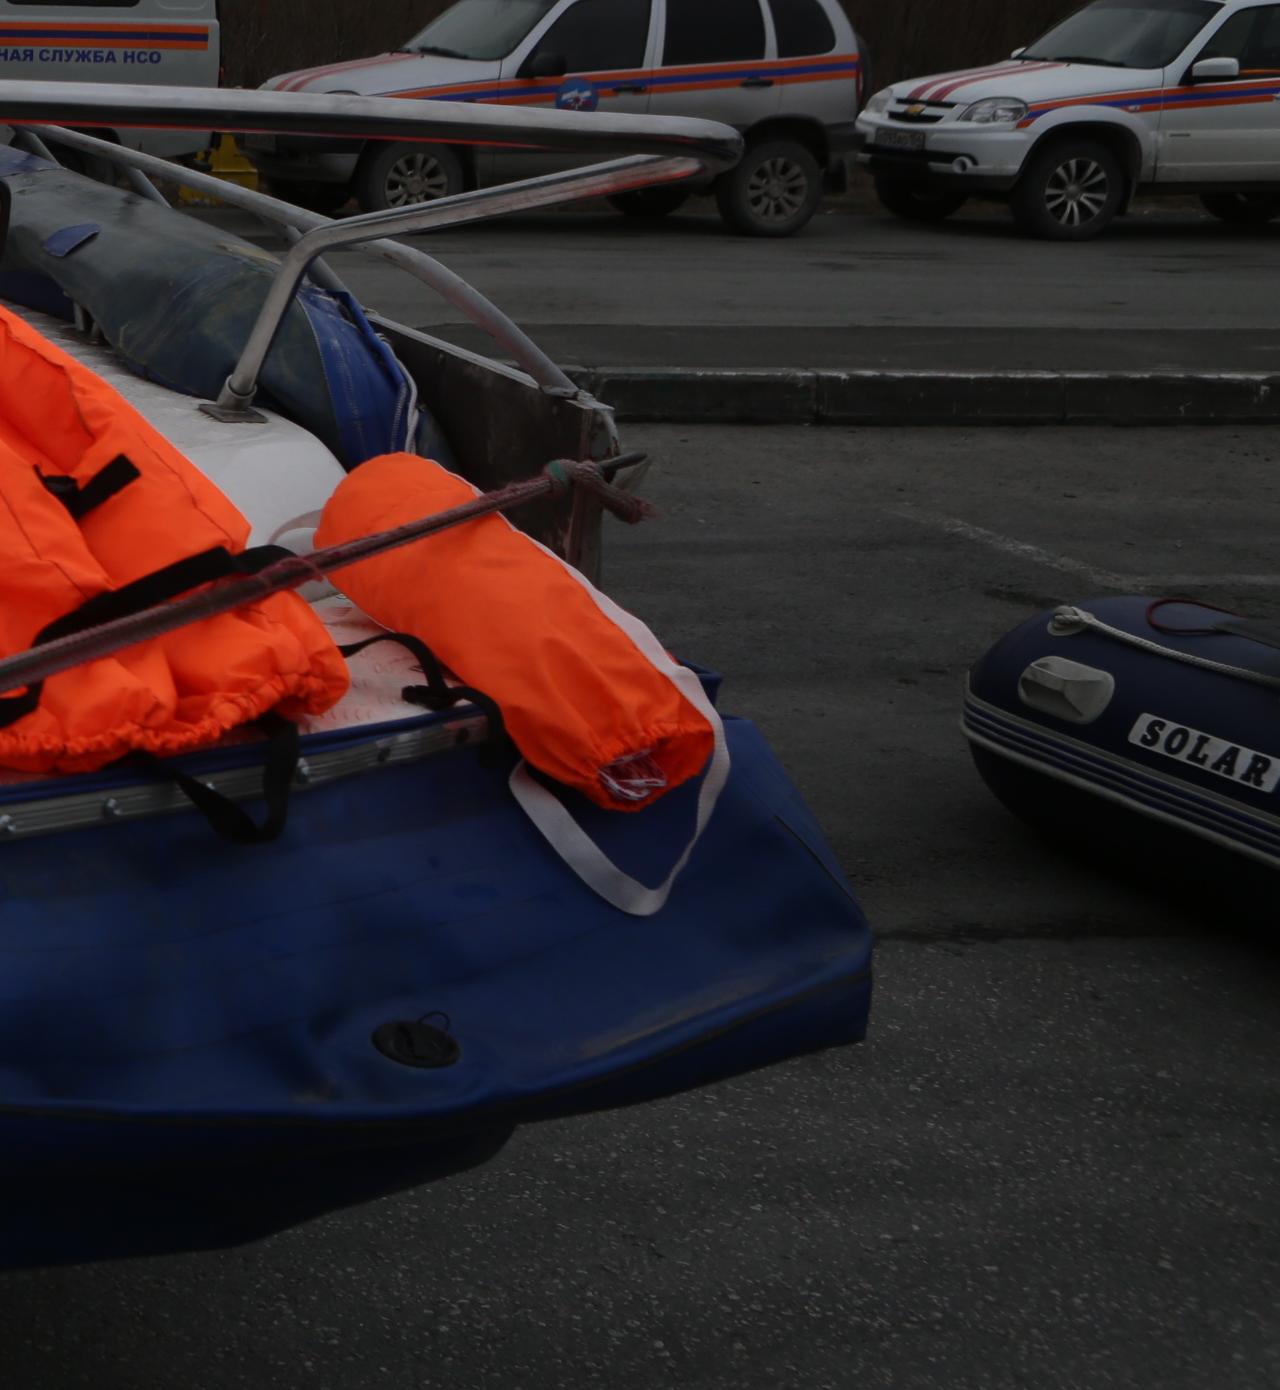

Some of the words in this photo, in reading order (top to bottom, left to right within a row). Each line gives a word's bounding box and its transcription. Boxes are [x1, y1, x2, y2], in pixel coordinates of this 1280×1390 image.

[39, 49, 117, 64] СЛУЖБА
[123, 51, 162, 64] НСО
[1140, 719, 1271, 787] SOLAR
